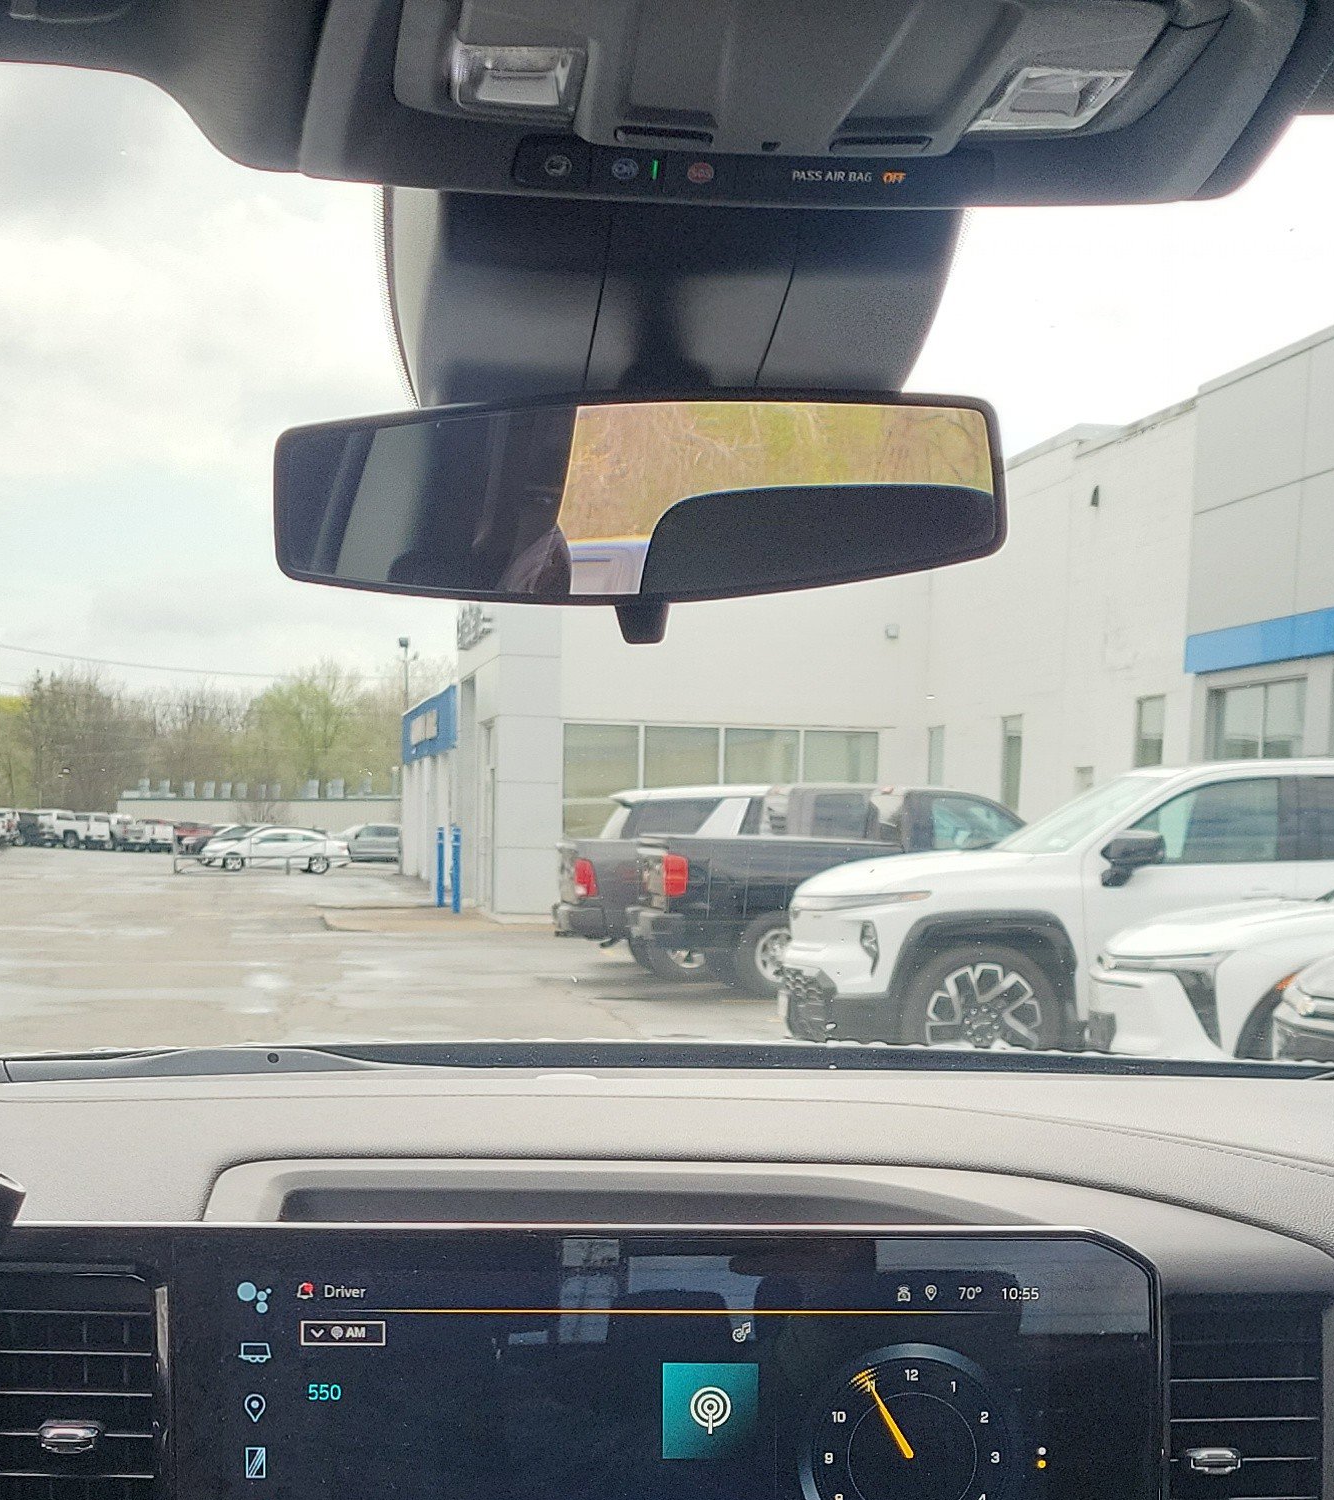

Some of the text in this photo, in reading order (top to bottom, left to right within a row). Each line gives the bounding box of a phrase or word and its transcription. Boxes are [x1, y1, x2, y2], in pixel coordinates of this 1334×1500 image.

[792, 170, 872, 183] PASS AIR BAG
[882, 171, 906, 185] OFF
[324, 1283, 366, 1301] Driver
[958, 1286, 982, 1301] 70°
[1001, 1286, 1040, 1301] 10:55
[345, 1326, 366, 1340] AM
[904, 1369, 919, 1382] 12
[307, 1384, 342, 1401] 550
[950, 1381, 958, 1392] 1
[832, 1411, 846, 1424] 10
[980, 1411, 989, 1424] 2
[824, 1452, 834, 1465] 9
[991, 1452, 1000, 1464] 3
